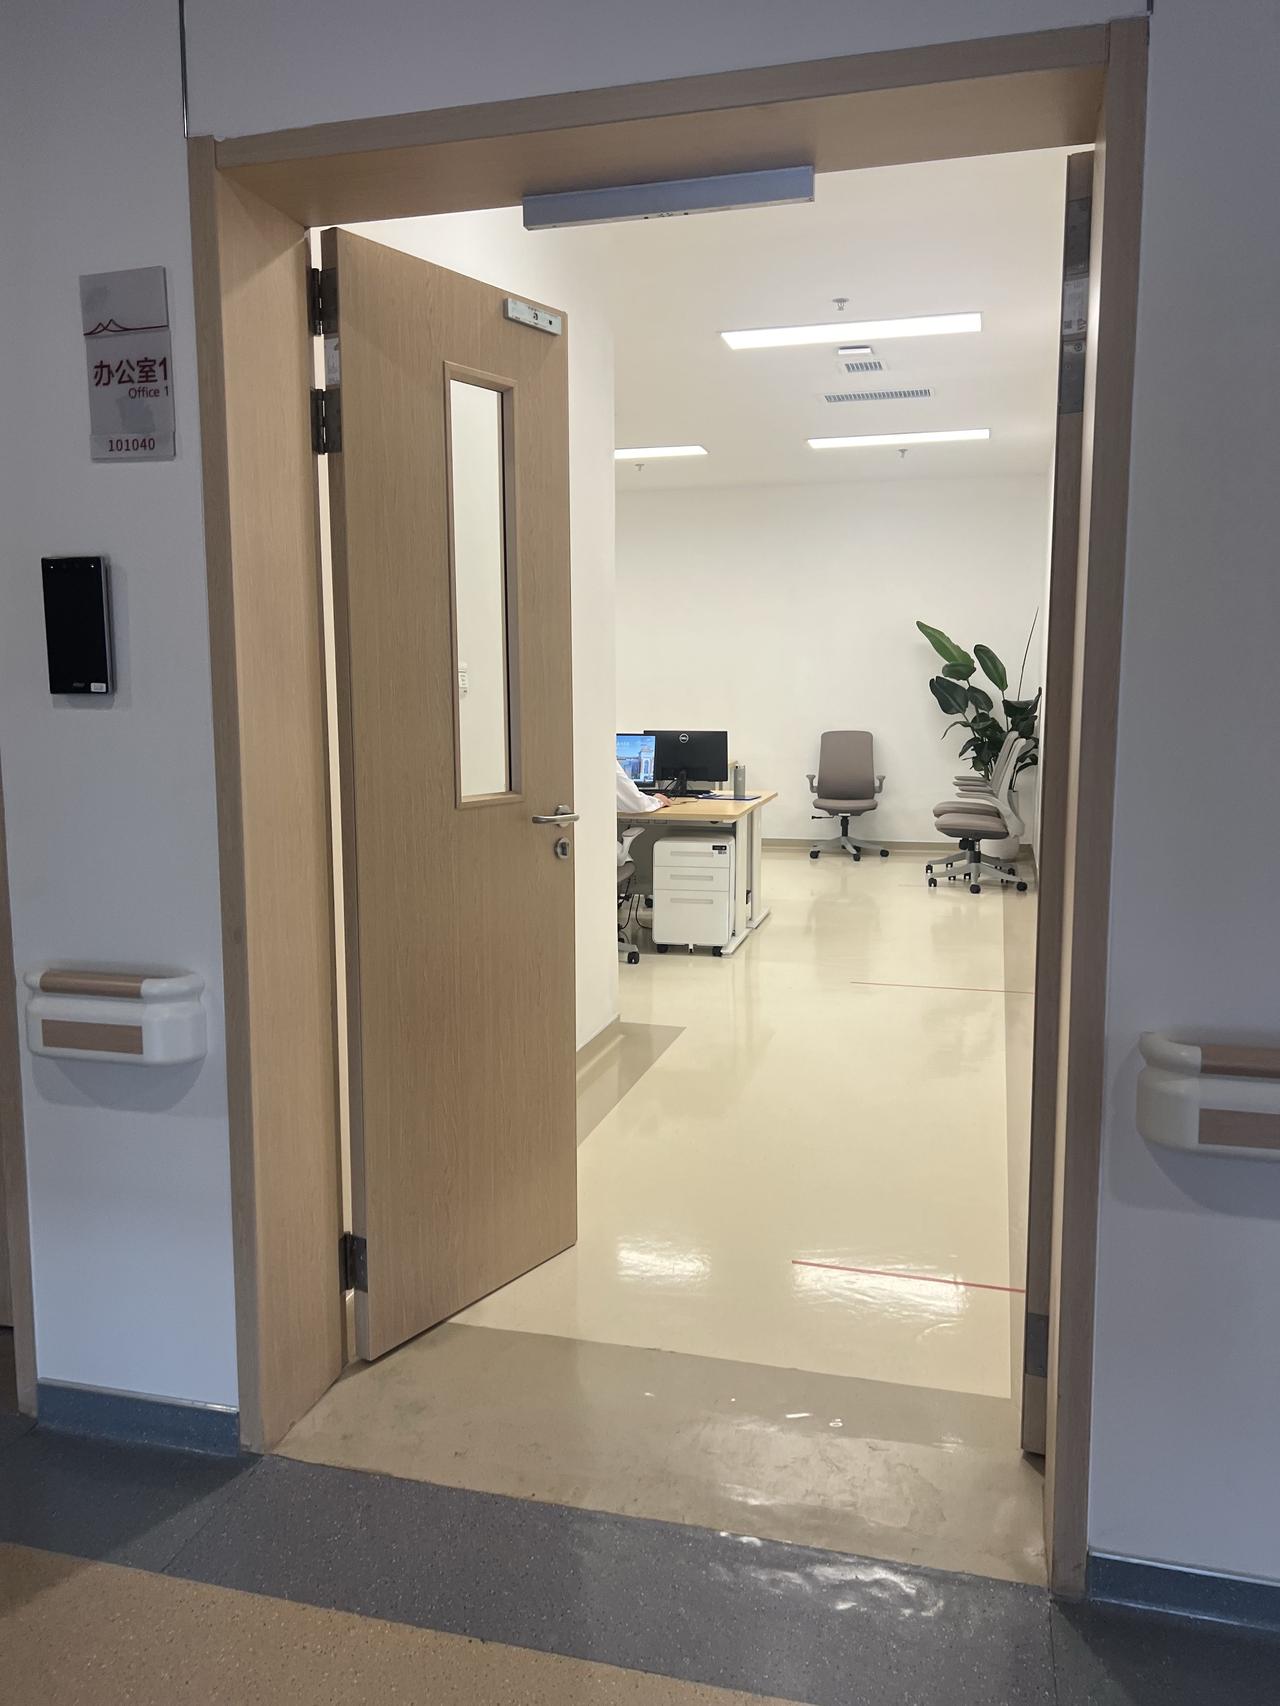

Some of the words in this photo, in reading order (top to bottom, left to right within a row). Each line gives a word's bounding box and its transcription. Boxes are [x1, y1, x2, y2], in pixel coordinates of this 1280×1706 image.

[94, 357, 168, 387] 办公室1
[128, 386, 160, 399] Office
[164, 385, 169, 397] 1
[108, 438, 156, 452] 101040
